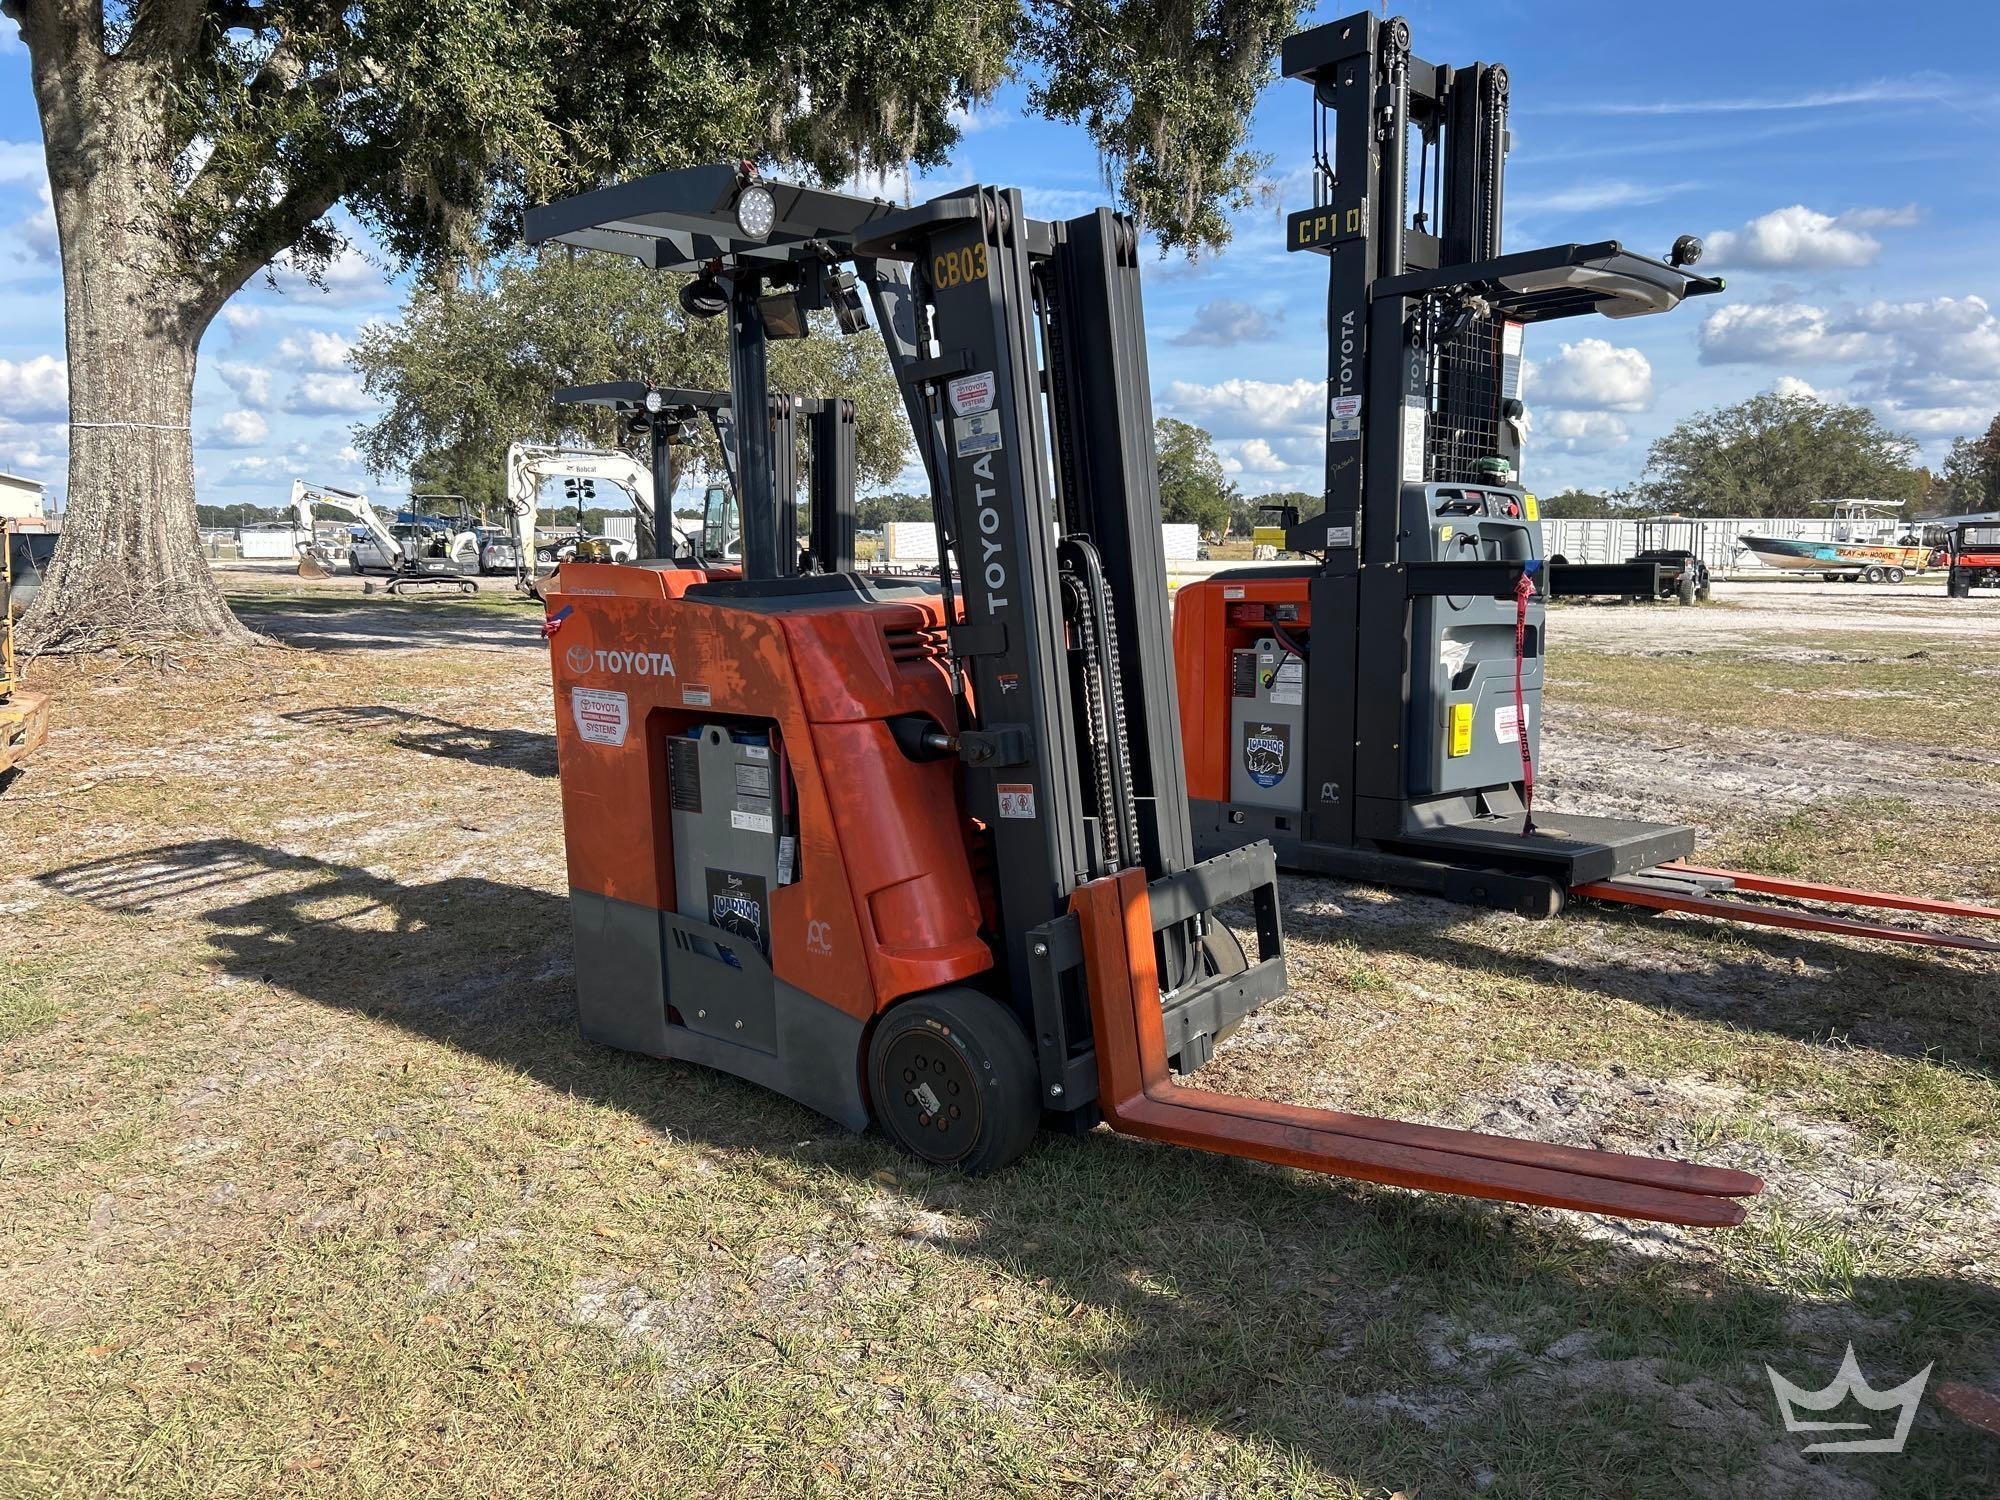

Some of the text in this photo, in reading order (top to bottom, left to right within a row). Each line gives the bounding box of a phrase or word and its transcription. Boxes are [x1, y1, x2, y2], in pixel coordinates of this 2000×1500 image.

[935, 242, 988, 289] CB03
[1340, 310, 1355, 396] TOYOTA
[965, 382, 988, 393] TOYOTA
[576, 465, 597, 473] Bobcat
[973, 453, 1009, 615] TOYOTA
[595, 650, 676, 677] TOYOTA
[591, 701, 620, 713] TOYOTA
[586, 722, 617, 735] SYSTEMS
[1518, 720, 1531, 763] DANGER
[1247, 738, 1284, 757] LOADHOG
[713, 894, 760, 924] LOADHOG
